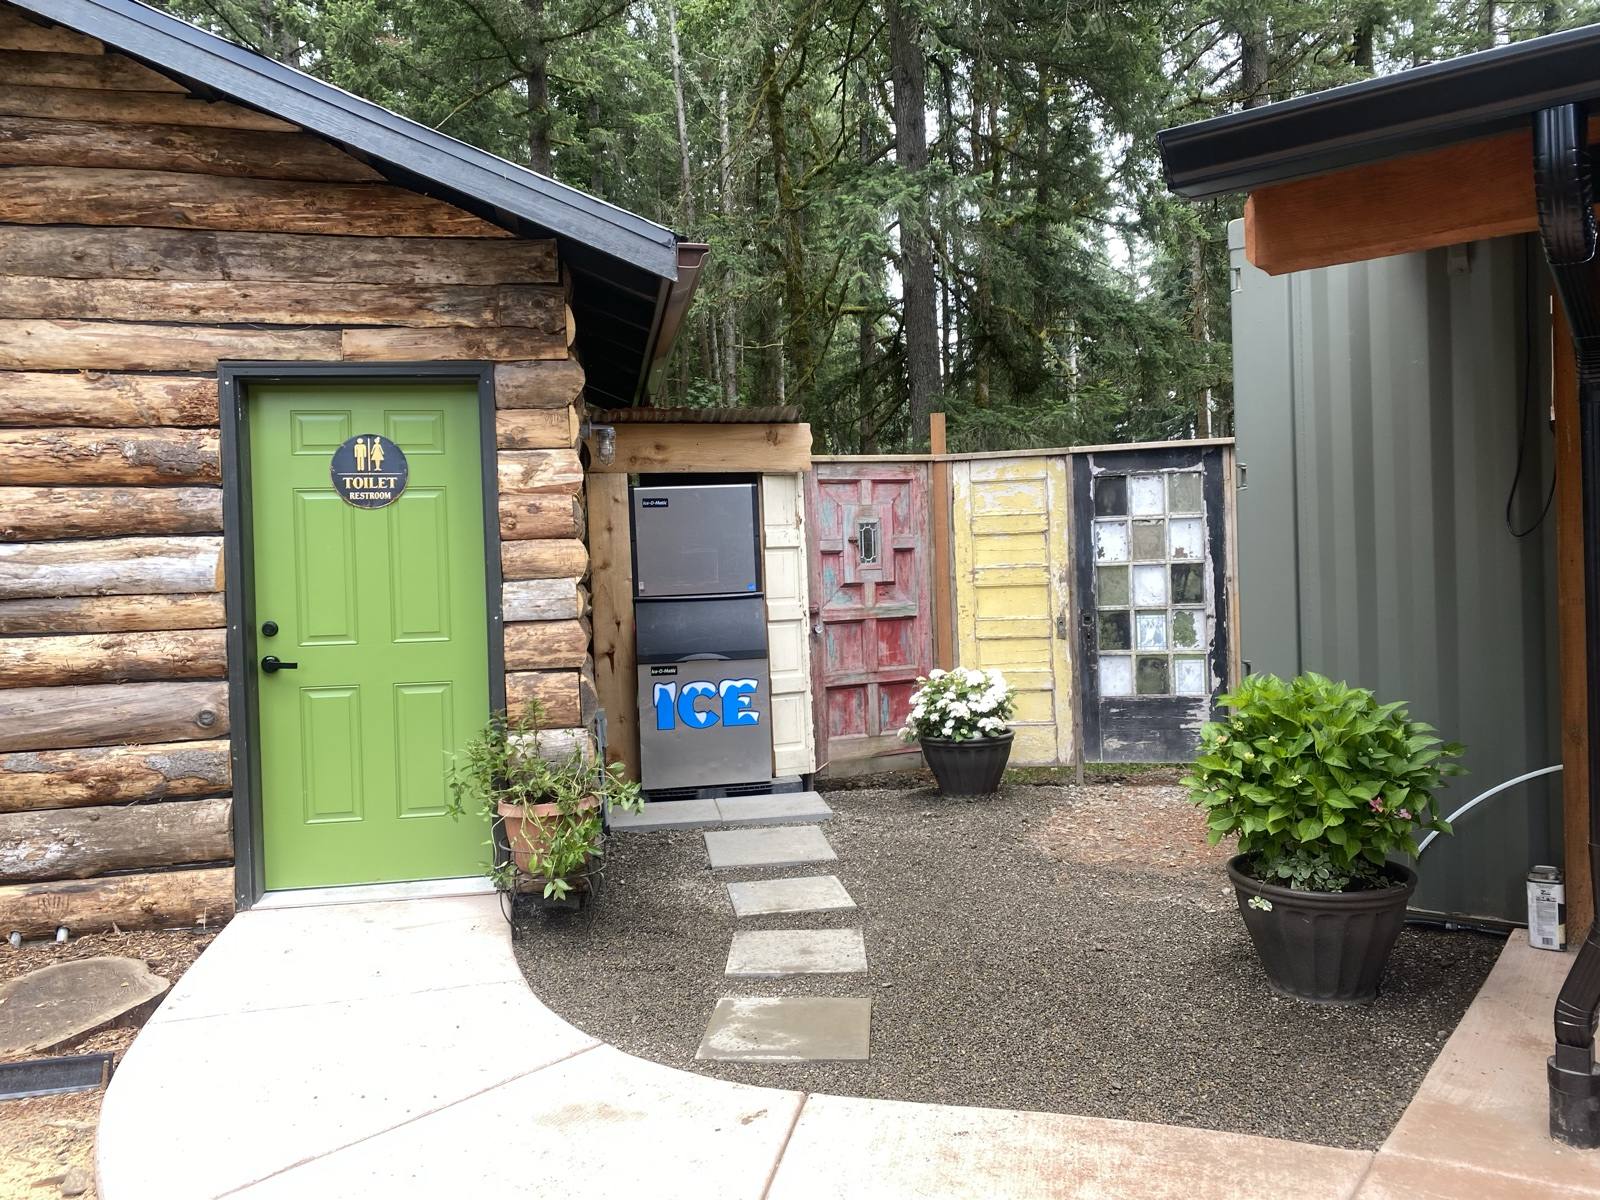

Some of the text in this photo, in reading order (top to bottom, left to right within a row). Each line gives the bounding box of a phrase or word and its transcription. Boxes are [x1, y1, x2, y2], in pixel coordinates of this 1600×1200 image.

[342, 477, 398, 489] TOILET
[349, 491, 391, 500] RESTROOM
[653, 679, 760, 730] ICE
